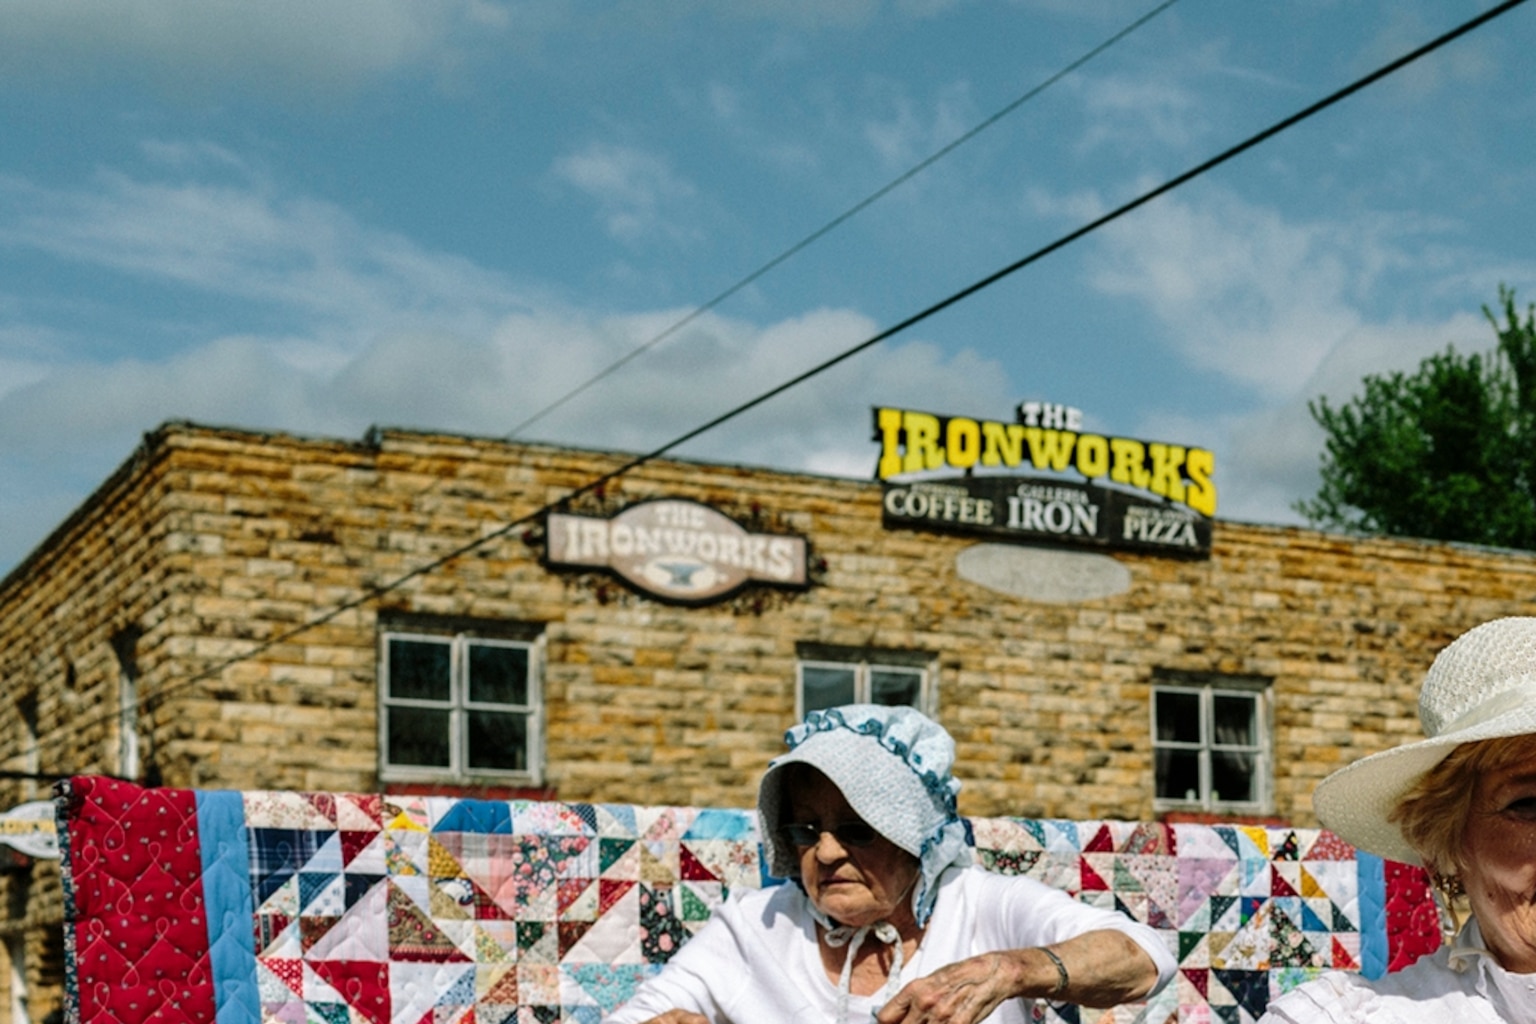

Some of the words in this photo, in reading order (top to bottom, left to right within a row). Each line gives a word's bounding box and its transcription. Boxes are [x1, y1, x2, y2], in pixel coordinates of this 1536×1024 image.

[1021, 401, 1083, 430] THE
[878, 407, 1217, 518] IRONWORKS
[654, 504, 706, 528] THE
[884, 488, 994, 526] COFFEE
[1006, 496, 1100, 537] IRON
[1122, 513, 1199, 547] PIZZA
[564, 520, 794, 579] IRONWORKS
